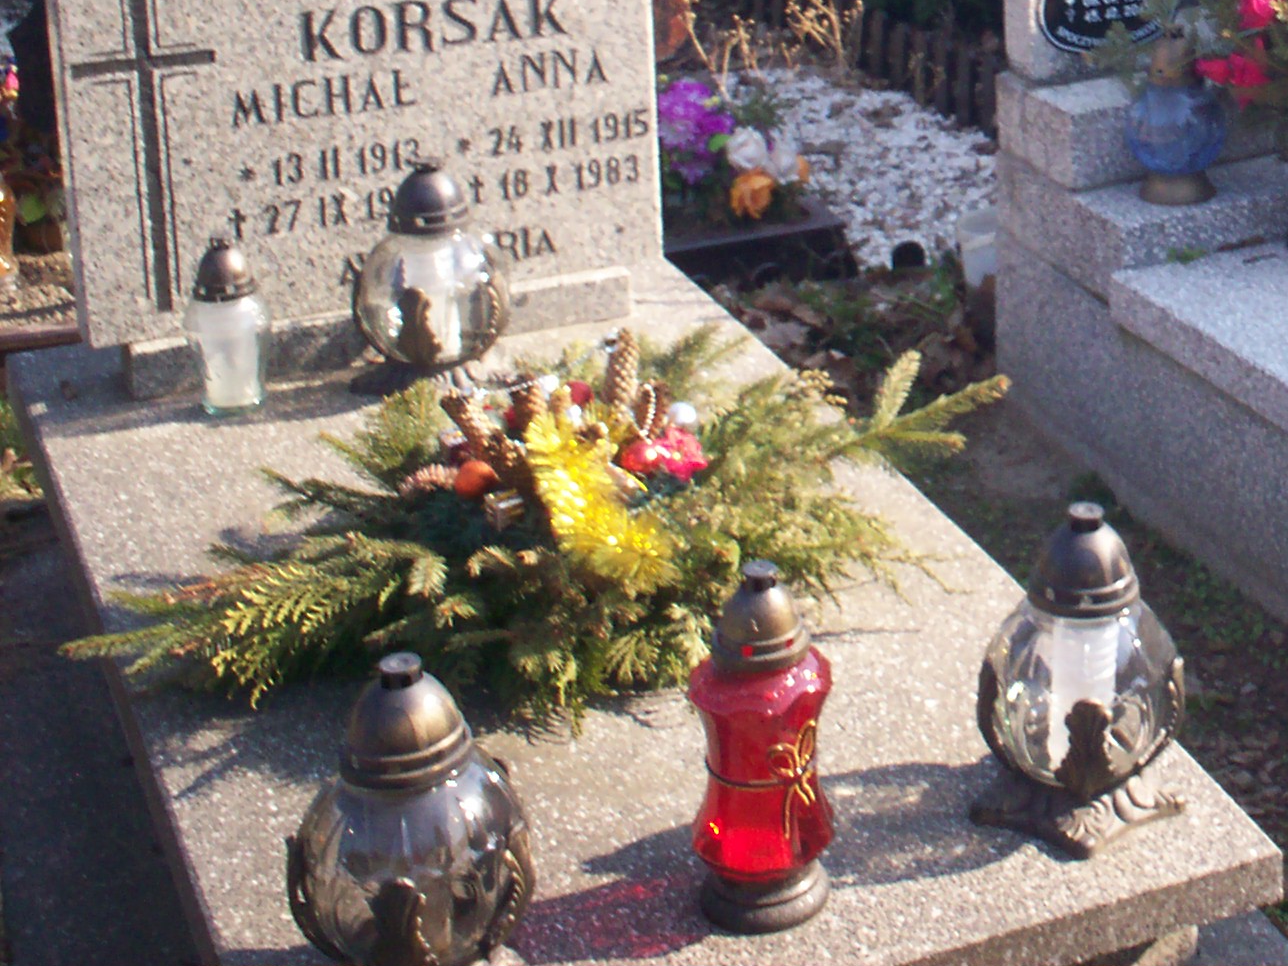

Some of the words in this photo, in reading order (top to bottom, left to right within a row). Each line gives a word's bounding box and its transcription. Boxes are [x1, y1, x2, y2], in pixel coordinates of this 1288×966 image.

[492, 48, 609, 96] ANNA
[489, 125, 524, 157] 24
[540, 117, 578, 152] XII
[591, 108, 649, 144] 1915
[272, 151, 304, 185] 13
[319, 146, 340, 181] II
[499, 168, 530, 201] 18
[546, 164, 560, 195] X
[575, 154, 640, 191] 1983
[264, 199, 302, 235] 27
[319, 193, 350, 227] IX
[367, 185, 396, 220] 19
[493, 226, 557, 262] RIA
